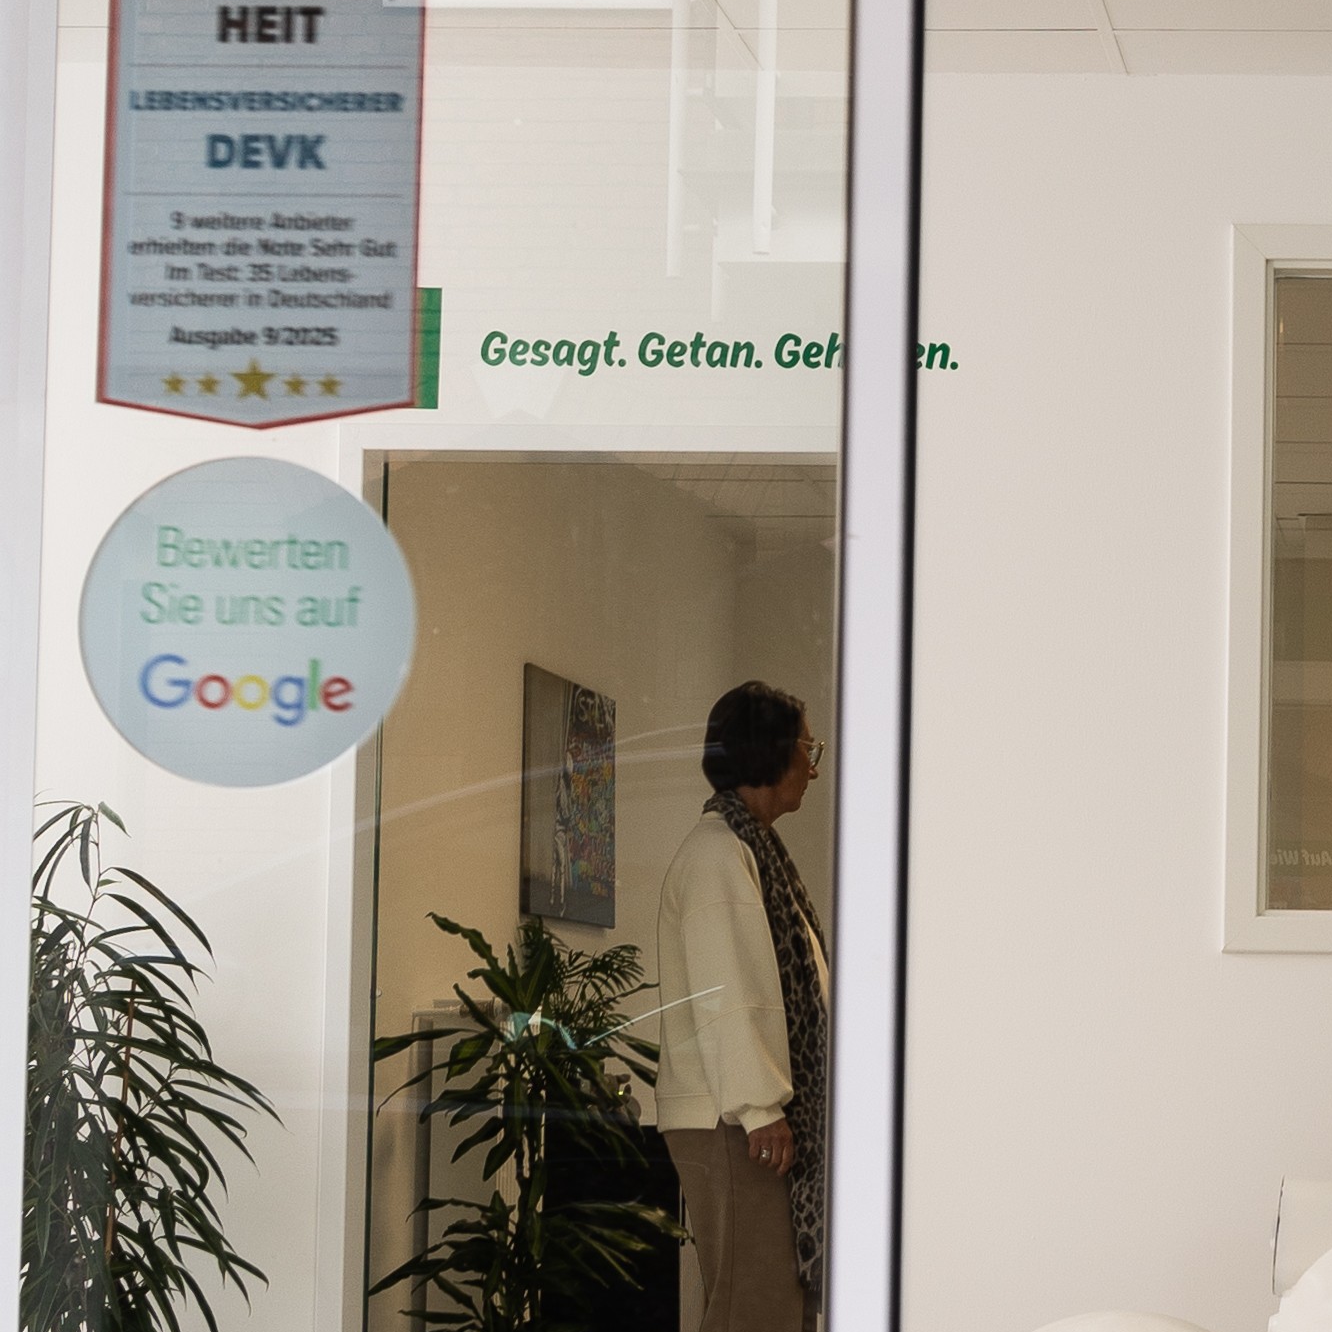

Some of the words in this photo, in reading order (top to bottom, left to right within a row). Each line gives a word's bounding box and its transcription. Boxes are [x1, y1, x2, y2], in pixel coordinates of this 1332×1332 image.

[217, 5, 324, 44] HEIT
[206, 132, 328, 170] DEVK
[480, 330, 628, 376] Gesagt.
[637, 331, 764, 369] Getan.
[774, 332, 960, 370] Gehn.
[154, 524, 349, 571] Bewerten
[139, 580, 205, 627] Sie
[214, 593, 287, 627] uns
[295, 585, 364, 628] auf
[138, 652, 355, 727] Google
